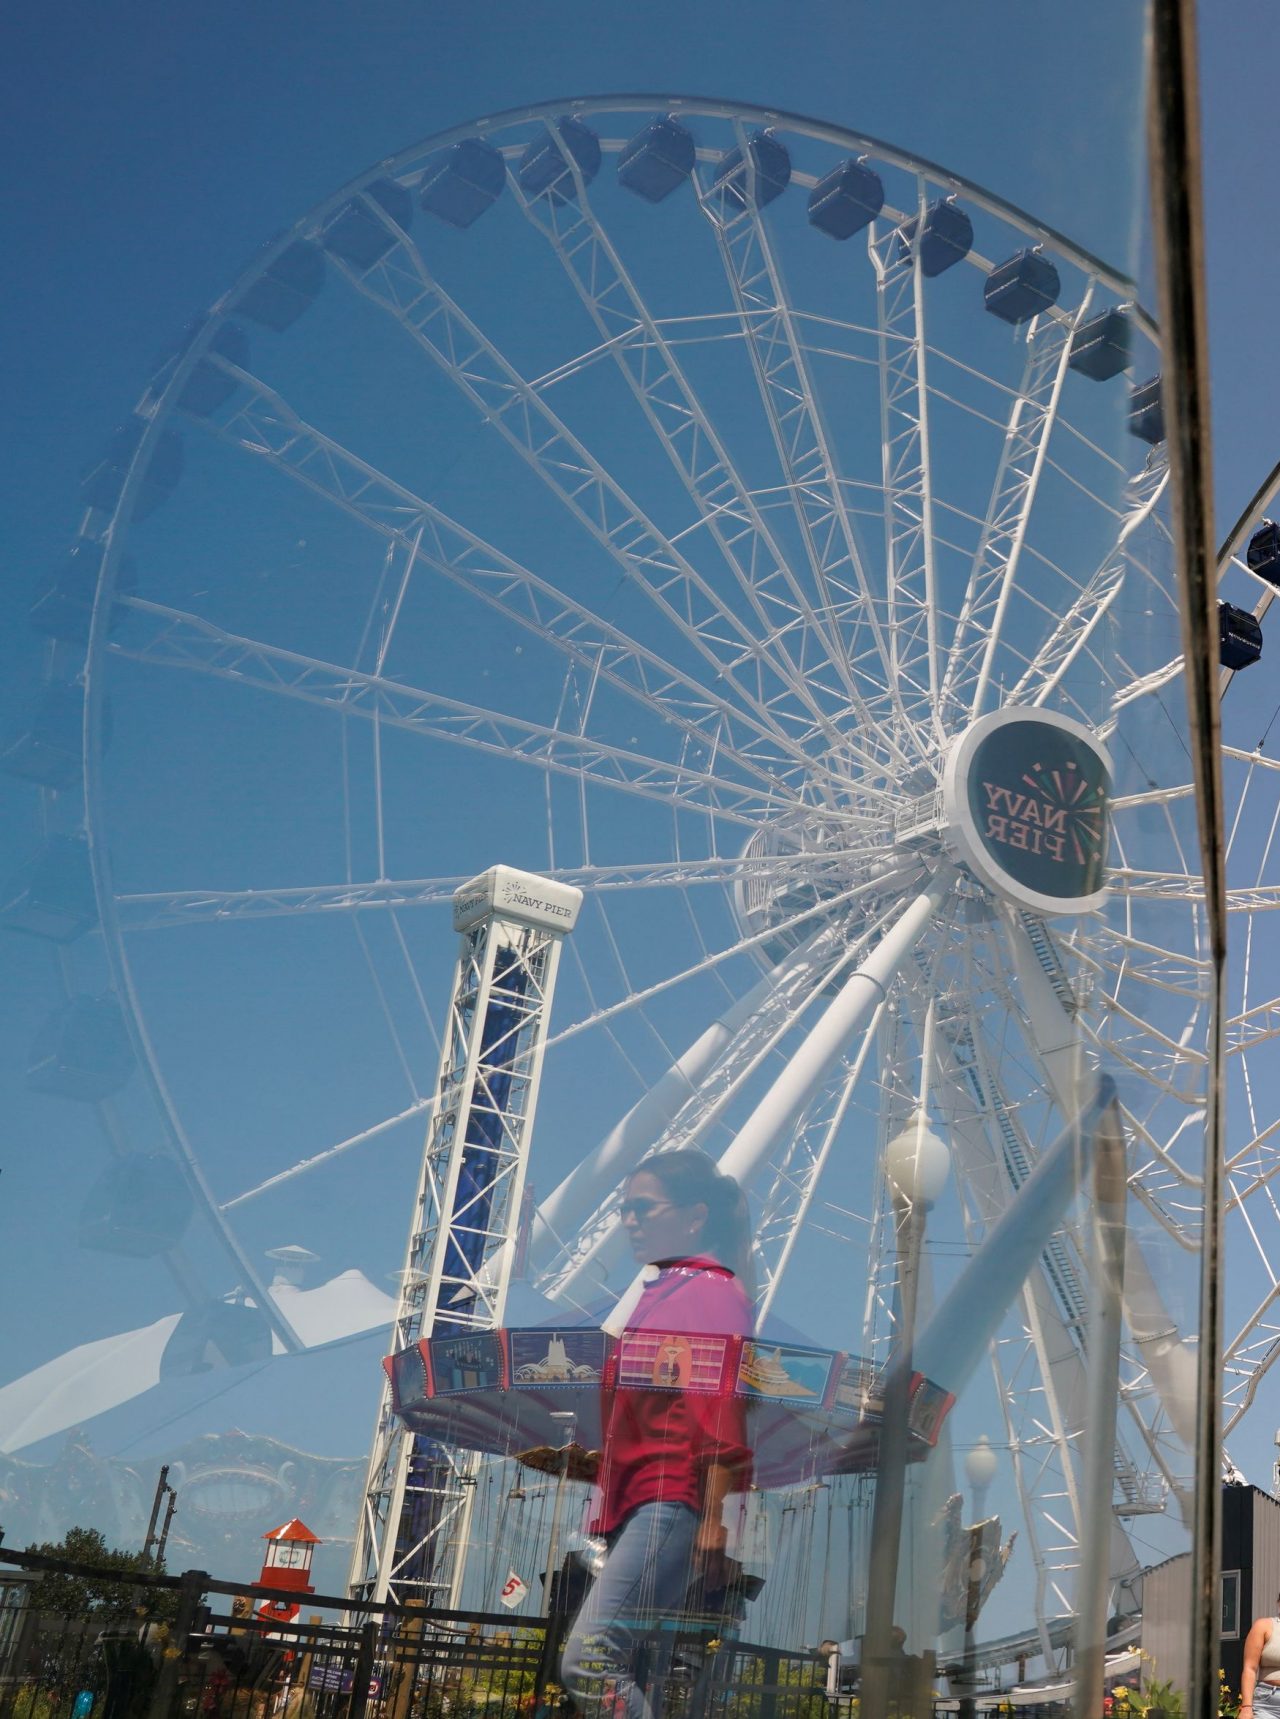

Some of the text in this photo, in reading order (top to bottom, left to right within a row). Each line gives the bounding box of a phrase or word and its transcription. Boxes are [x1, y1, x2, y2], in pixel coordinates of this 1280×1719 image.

[513, 893, 572, 918] NAVY PIER
[502, 1578, 521, 1596] 5
